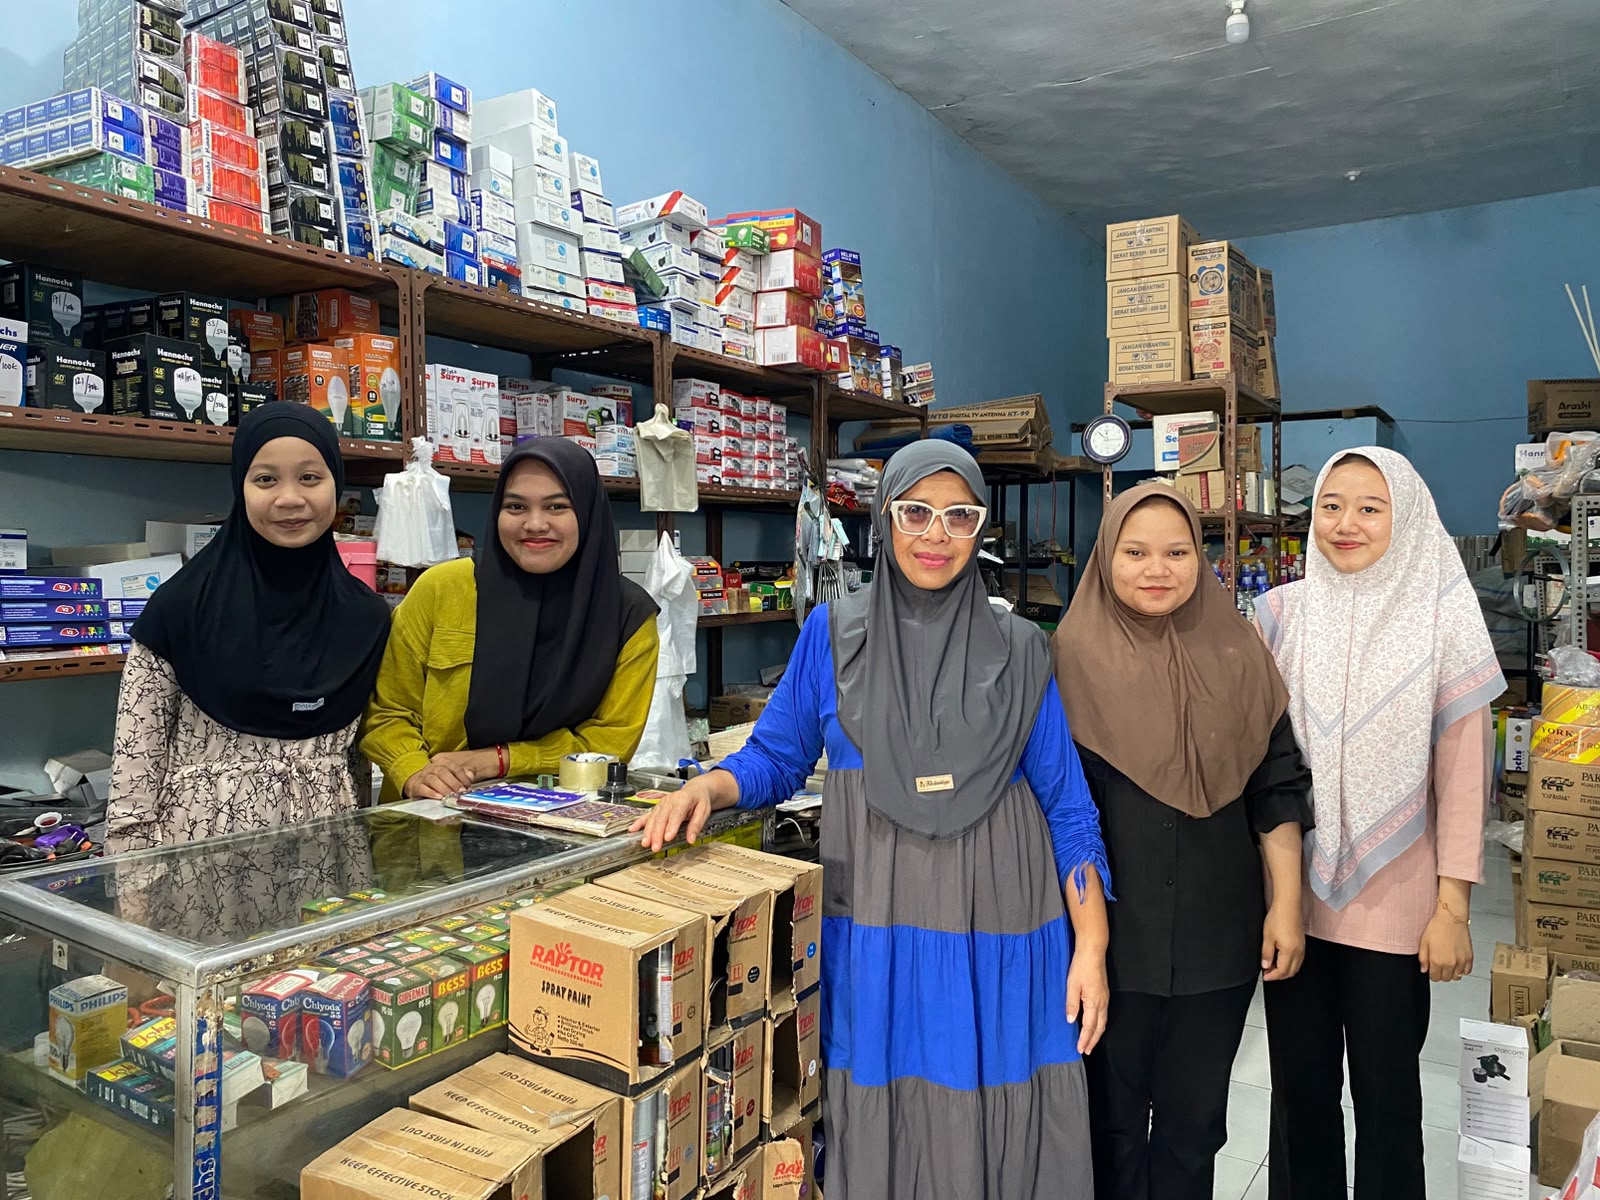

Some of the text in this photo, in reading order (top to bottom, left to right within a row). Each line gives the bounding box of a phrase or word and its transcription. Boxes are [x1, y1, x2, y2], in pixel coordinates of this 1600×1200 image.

[396, 211, 411, 224] HSC
[1116, 229, 1137, 238] JANGAN
[390, 238, 406, 250] HSC
[1113, 251, 1129, 260] BERAT
[35, 273, 73, 288] Hannochs
[1116, 286, 1138, 295] JANGAN
[189, 298, 223, 311] Hannochs
[1114, 307, 1130, 316] BERAT
[112, 348, 141, 360] Hannochs
[1121, 342, 1142, 351] JANGAN
[56, 355, 96, 369] Hannochs
[157, 347, 194, 362] Hannochs
[312, 360, 347, 370] MARLIN
[1118, 364, 1134, 373] BERAT
[54, 374, 65, 382] 40
[440, 372, 496, 389] Surya Surya
[508, 381, 529, 391] Surya
[566, 395, 588, 405] Surya
[1558, 401, 1592, 411] Arashi
[1541, 726, 1574, 738] YORK
[656, 866, 740, 894] KEEP EFFECTIVE STOCK
[725, 866, 747, 875] FIRST
[747, 873, 765, 881] OUT
[633, 881, 655, 890] FIRST
[588, 895, 665, 919] FIRST IN FIRST OUT
[544, 907, 636, 937] KEEP EFFECTIVE STOCK
[734, 914, 758, 933] TOR
[477, 958, 503, 979] BESS
[531, 942, 605, 981] RAPTOR
[1571, 960, 1600, 973] PAKU
[437, 974, 466, 996] BESS
[81, 990, 128, 1012] PHILIPS
[398, 984, 431, 1006] SUPERMAX
[541, 980, 592, 1008] SPRAY PAINT
[50, 994, 75, 1013] PHILIPS
[242, 995, 278, 1012] Chiyoda
[302, 997, 342, 1012] Chiyoda
[329, 1011, 342, 1019] 55
[499, 1070, 579, 1106] FIRST IN FIRST OUT
[444, 1090, 541, 1136] KEEP EFFECTIVE STOCK
[400, 1125, 495, 1159] FIRST IN FIRST OUT
[340, 1156, 456, 1200] KEEP EFFECTIVE STOCK
